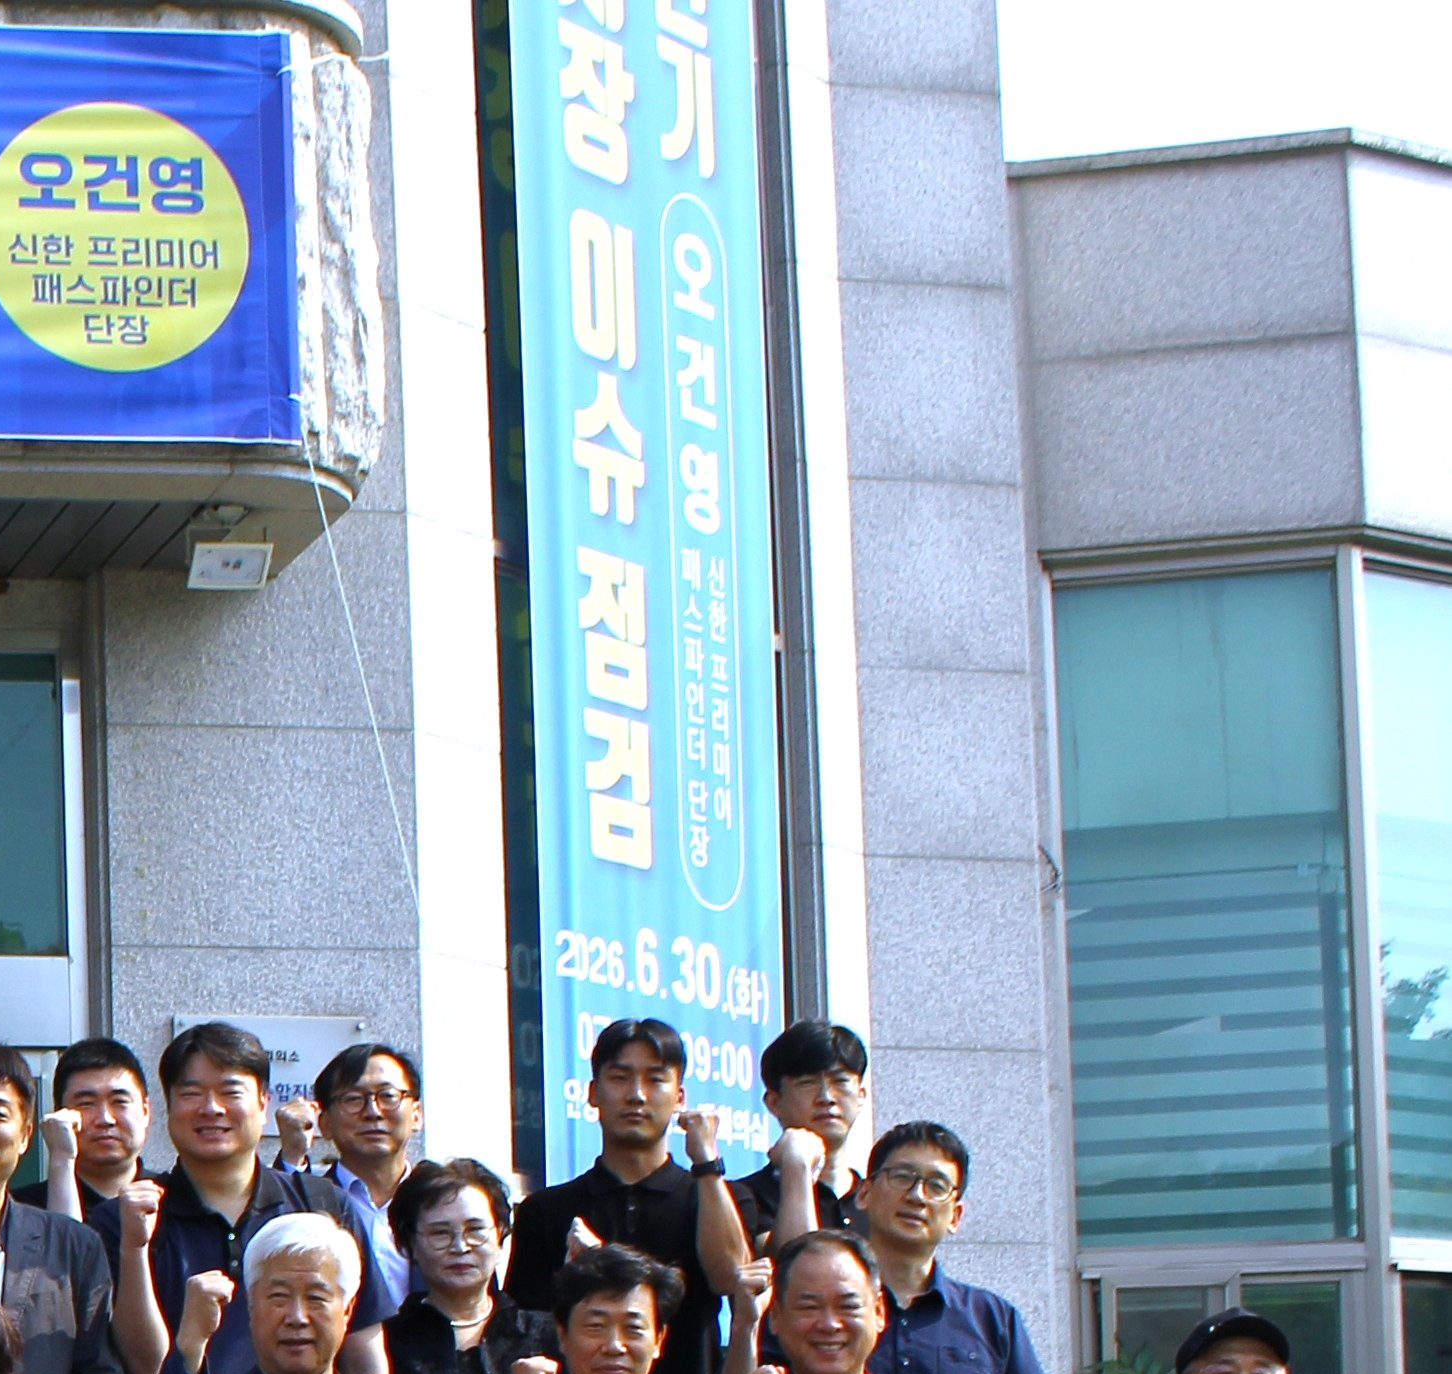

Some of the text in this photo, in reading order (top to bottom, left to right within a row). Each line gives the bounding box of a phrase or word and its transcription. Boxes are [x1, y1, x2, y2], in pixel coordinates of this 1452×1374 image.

[9, 234, 220, 273] 신한 프리미어
[17, 150, 205, 215] 오건영
[34, 275, 197, 307] 패스파인더
[86, 315, 149, 345] 단장
[569, 208, 645, 526] 이슈
[672, 232, 721, 535] 오건영
[576, 544, 654, 870] 점검
[680, 546, 711, 869] 패스파인더 단장
[706, 555, 733, 831] 신한 프리미어
